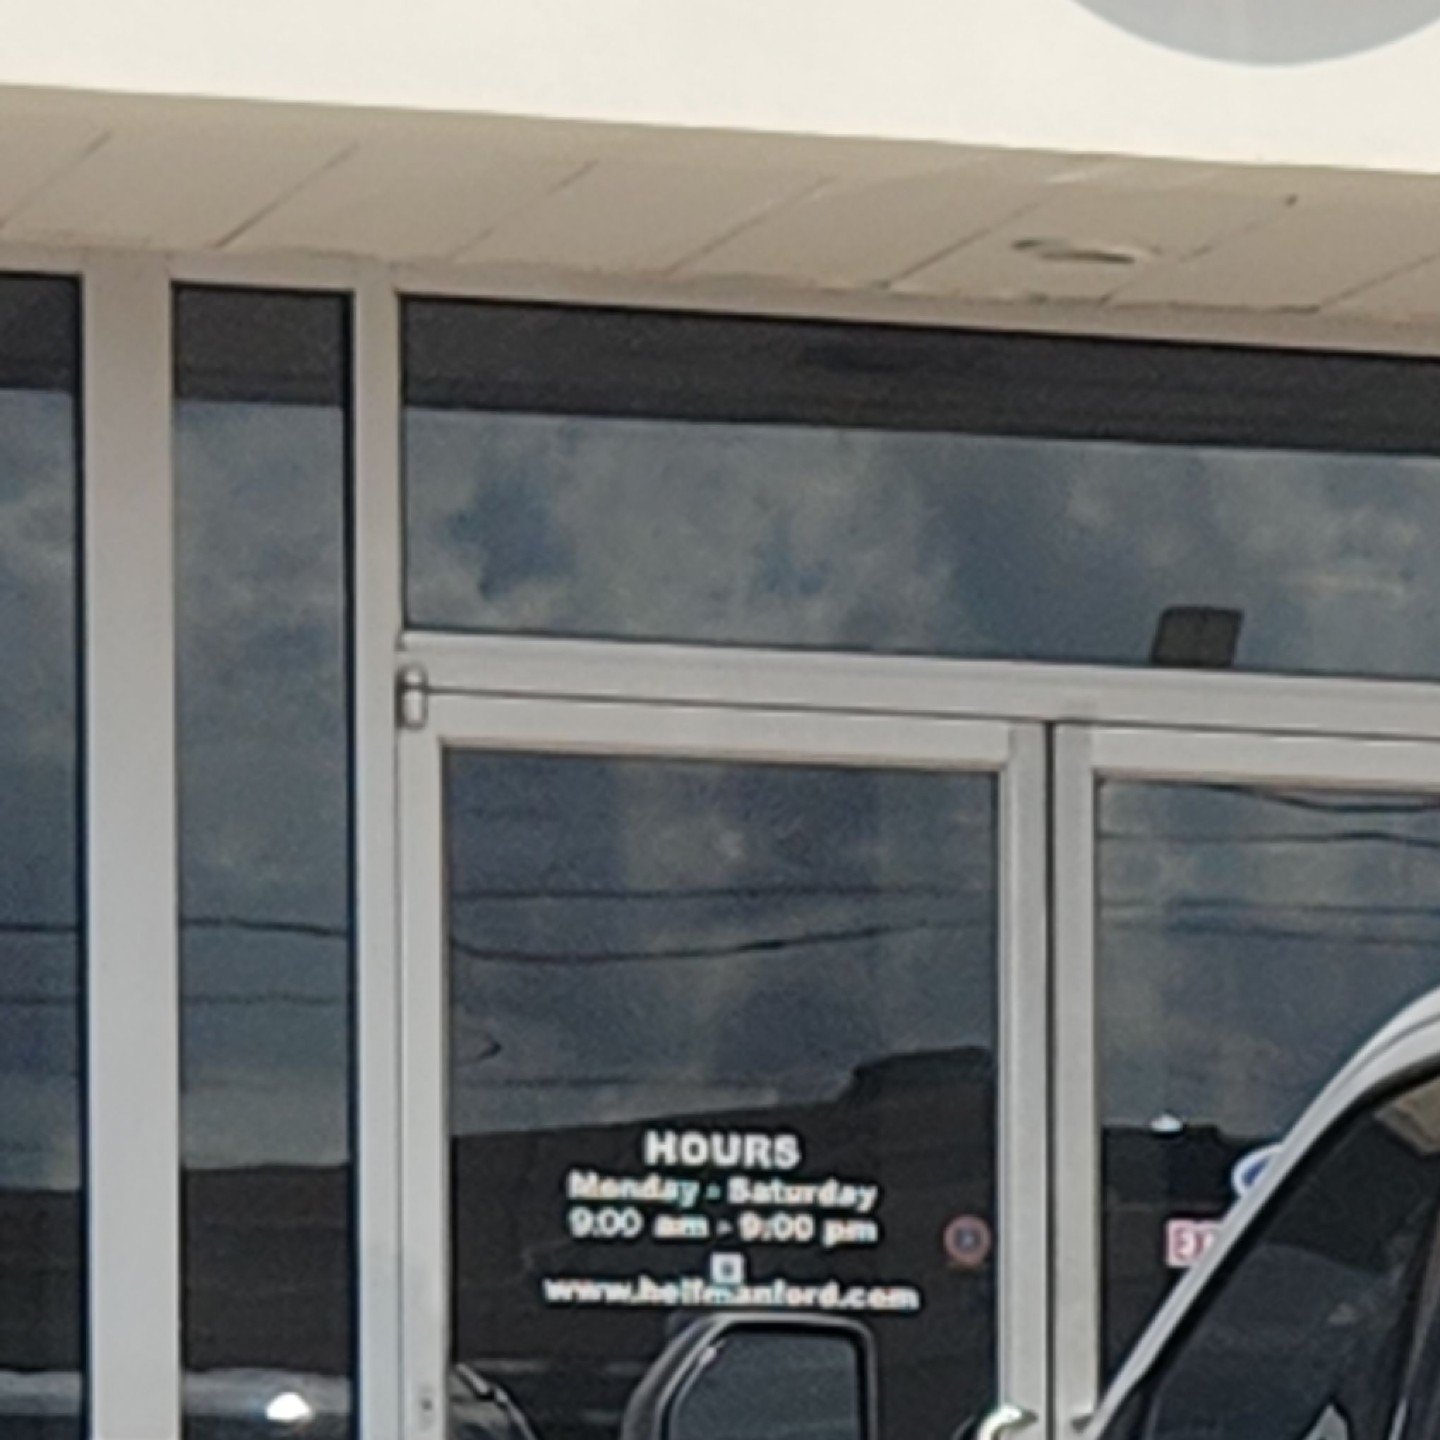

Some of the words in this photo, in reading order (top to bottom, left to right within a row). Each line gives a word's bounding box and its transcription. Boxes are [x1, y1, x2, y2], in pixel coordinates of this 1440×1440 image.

[643, 1130, 802, 1169] HOURS
[566, 1170, 700, 1208] Monday
[726, 1177, 879, 1212] Saturday
[568, 1207, 643, 1239] 9:00
[652, 1214, 710, 1240] am
[737, 1212, 816, 1243] 9:00
[823, 1217, 880, 1248] pm
